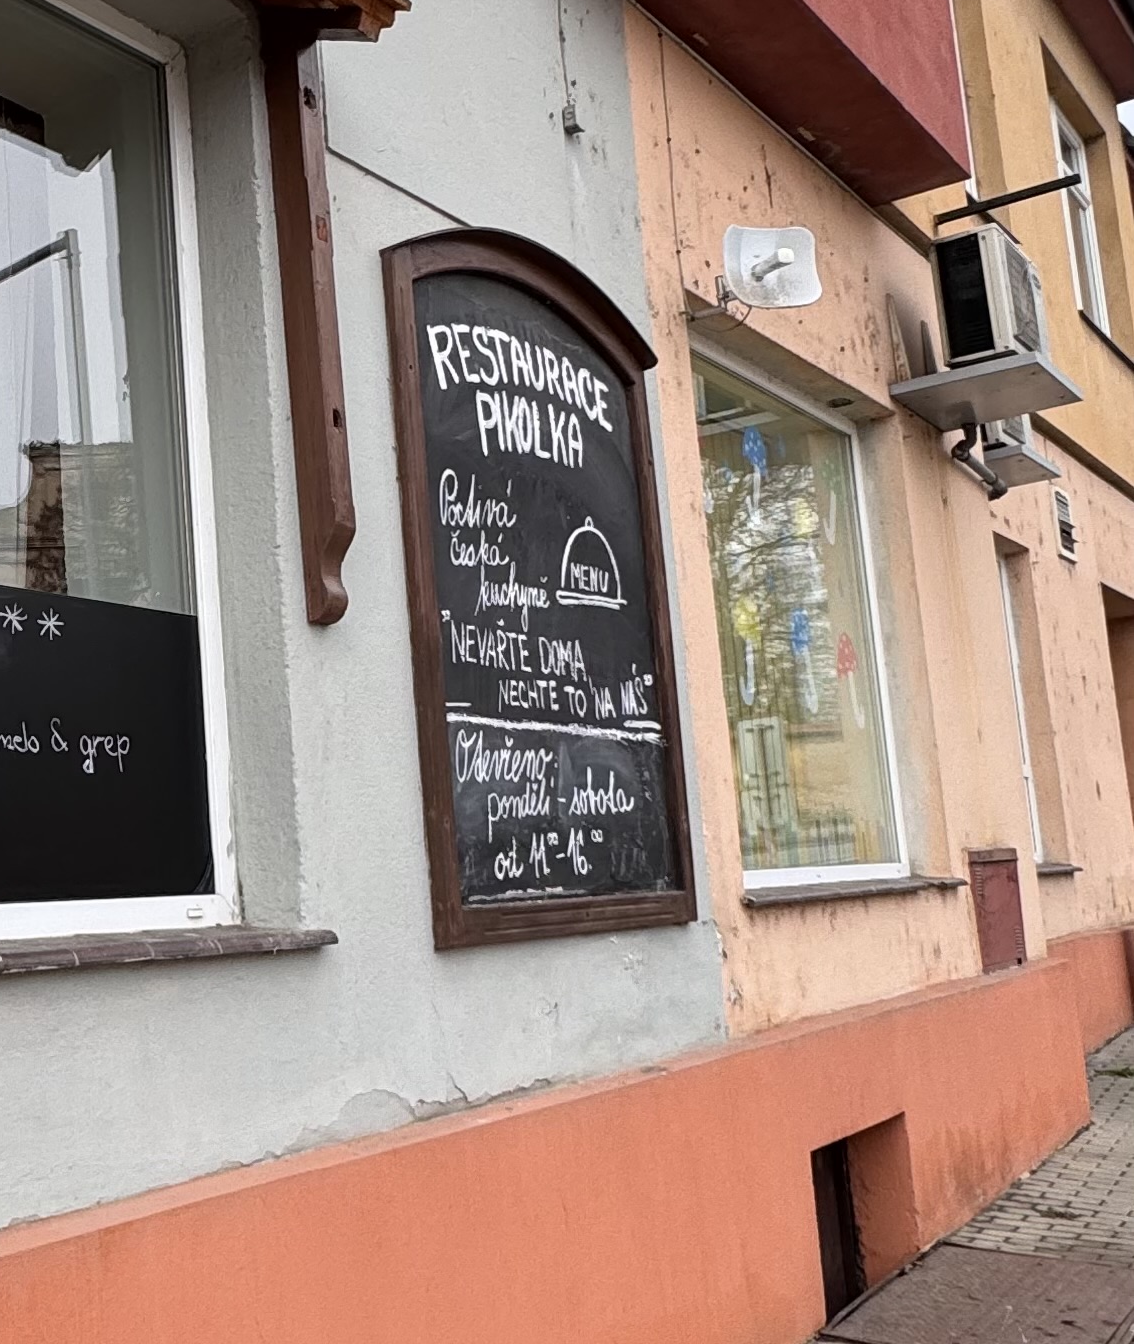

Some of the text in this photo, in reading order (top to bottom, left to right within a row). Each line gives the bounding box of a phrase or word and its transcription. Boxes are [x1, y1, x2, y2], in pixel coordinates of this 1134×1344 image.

[426, 322, 614, 433] RESTAURACE
[475, 388, 584, 469] PIKOLKA
[439, 468, 517, 529] Poctivá
[474, 560, 551, 633] kuchyně
[570, 561, 609, 593] MENU
[497, 679, 560, 713] NECHTE
[563, 685, 588, 718] TO
[592, 686, 617, 721] NA
[50, 716, 69, 752] &
[79, 733, 131, 774] grep
[487, 775, 555, 844] pondělí
[568, 765, 635, 816] sobota
[494, 835, 524, 881] od
